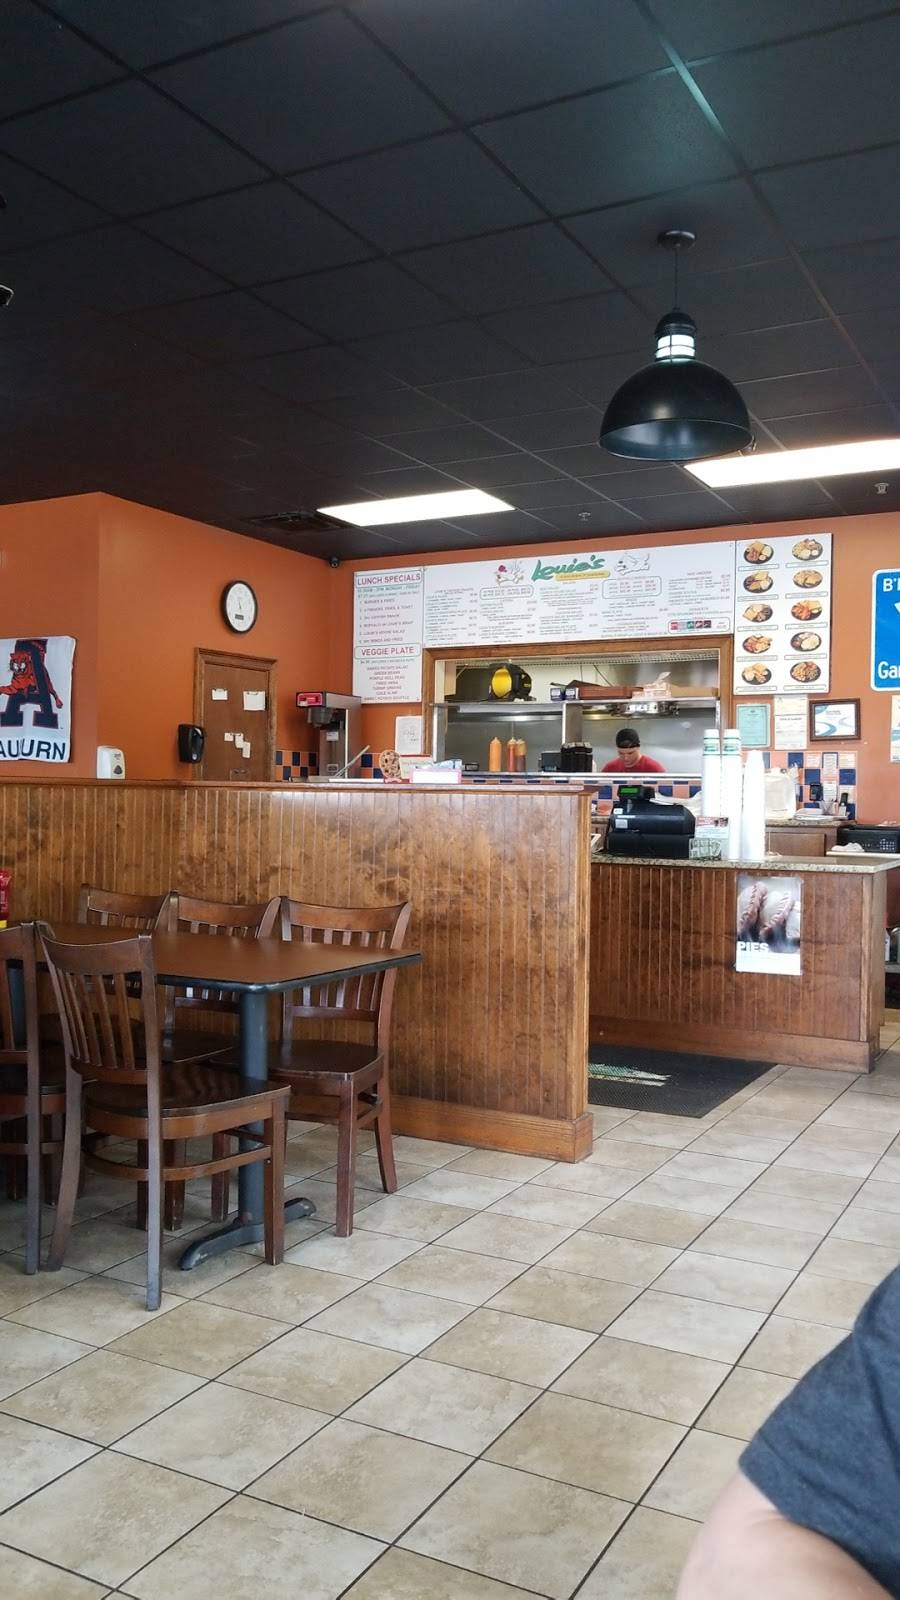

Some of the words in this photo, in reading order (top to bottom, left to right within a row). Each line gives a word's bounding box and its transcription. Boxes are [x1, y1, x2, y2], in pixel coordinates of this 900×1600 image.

[531, 554, 605, 581] Louie's
[357, 576, 383, 586] LUNCH
[384, 573, 421, 584] SPECIALS
[361, 648, 389, 656] VEGGIE
[390, 646, 415, 655] PLATE
[878, 660, 900, 680] Ga
